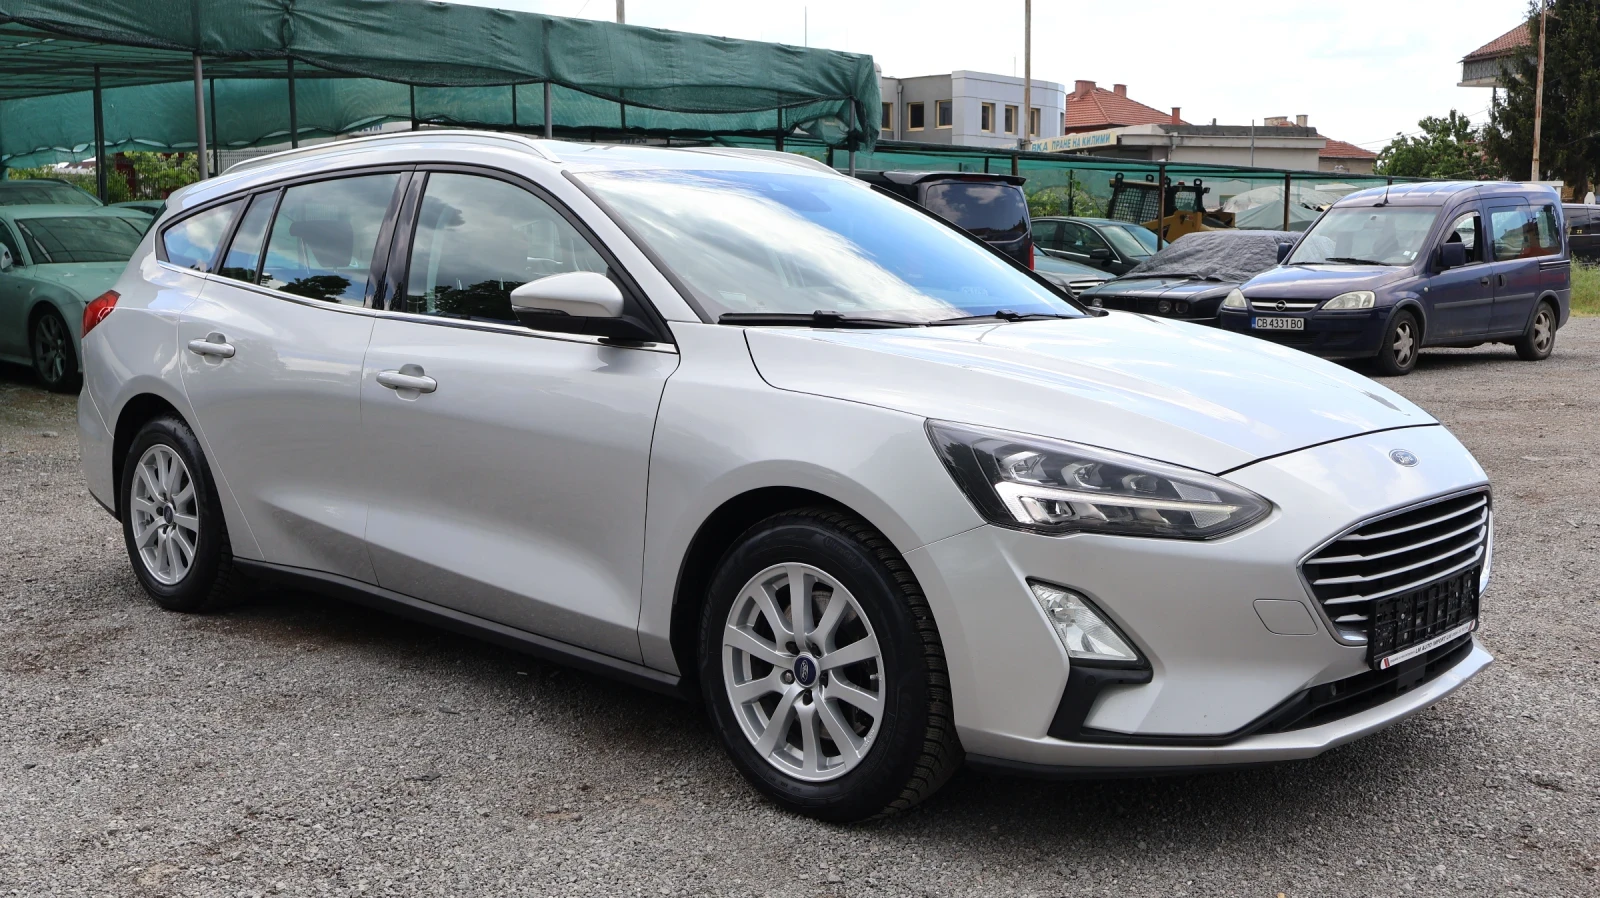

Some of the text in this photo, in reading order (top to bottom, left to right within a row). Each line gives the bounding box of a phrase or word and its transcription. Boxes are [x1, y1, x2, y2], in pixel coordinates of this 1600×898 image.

[1052, 139, 1071, 150] ПРАНЕ
[1072, 137, 1080, 147] НА
[1081, 133, 1111, 146] КИЛИМИ
